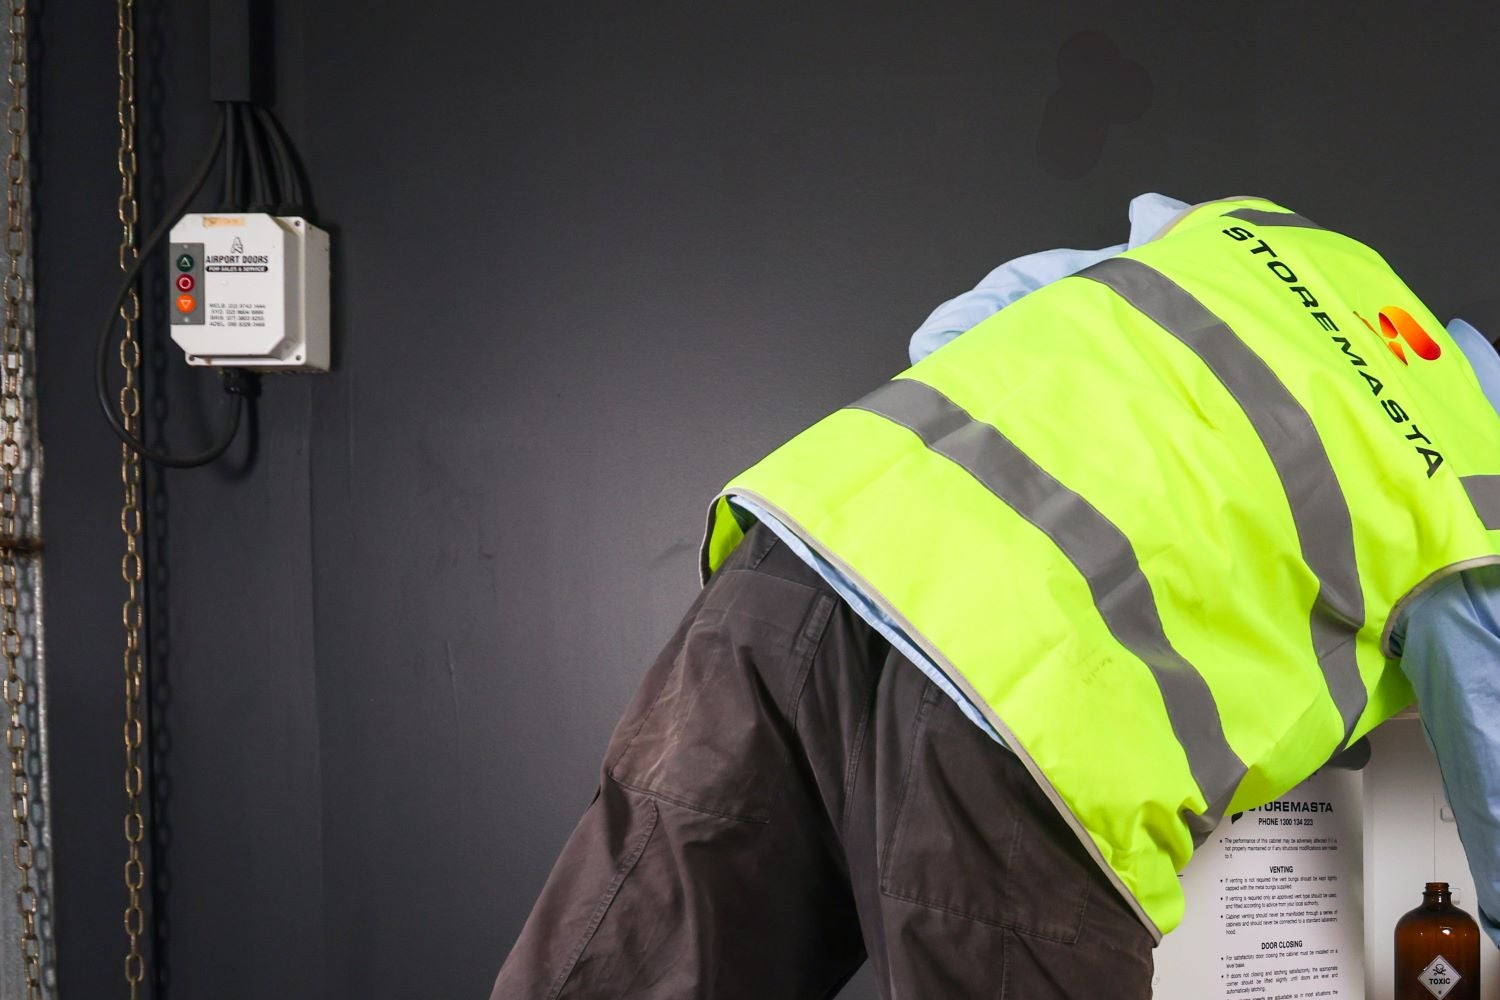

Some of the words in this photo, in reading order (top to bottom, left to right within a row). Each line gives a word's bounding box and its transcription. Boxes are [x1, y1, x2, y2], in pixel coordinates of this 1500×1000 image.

[206, 255, 239, 264] AIRPORT
[242, 255, 268, 264] DOORS
[1222, 226, 1444, 479] STOREMASTA
[1248, 801, 1333, 813] OREMASTA
[1258, 817, 1279, 826] PHONE
[1280, 818, 1293, 826] 1300
[1293, 818, 1303, 826] 134
[1261, 941, 1278, 950] DOOR
[1278, 940, 1303, 949] CLOSING
